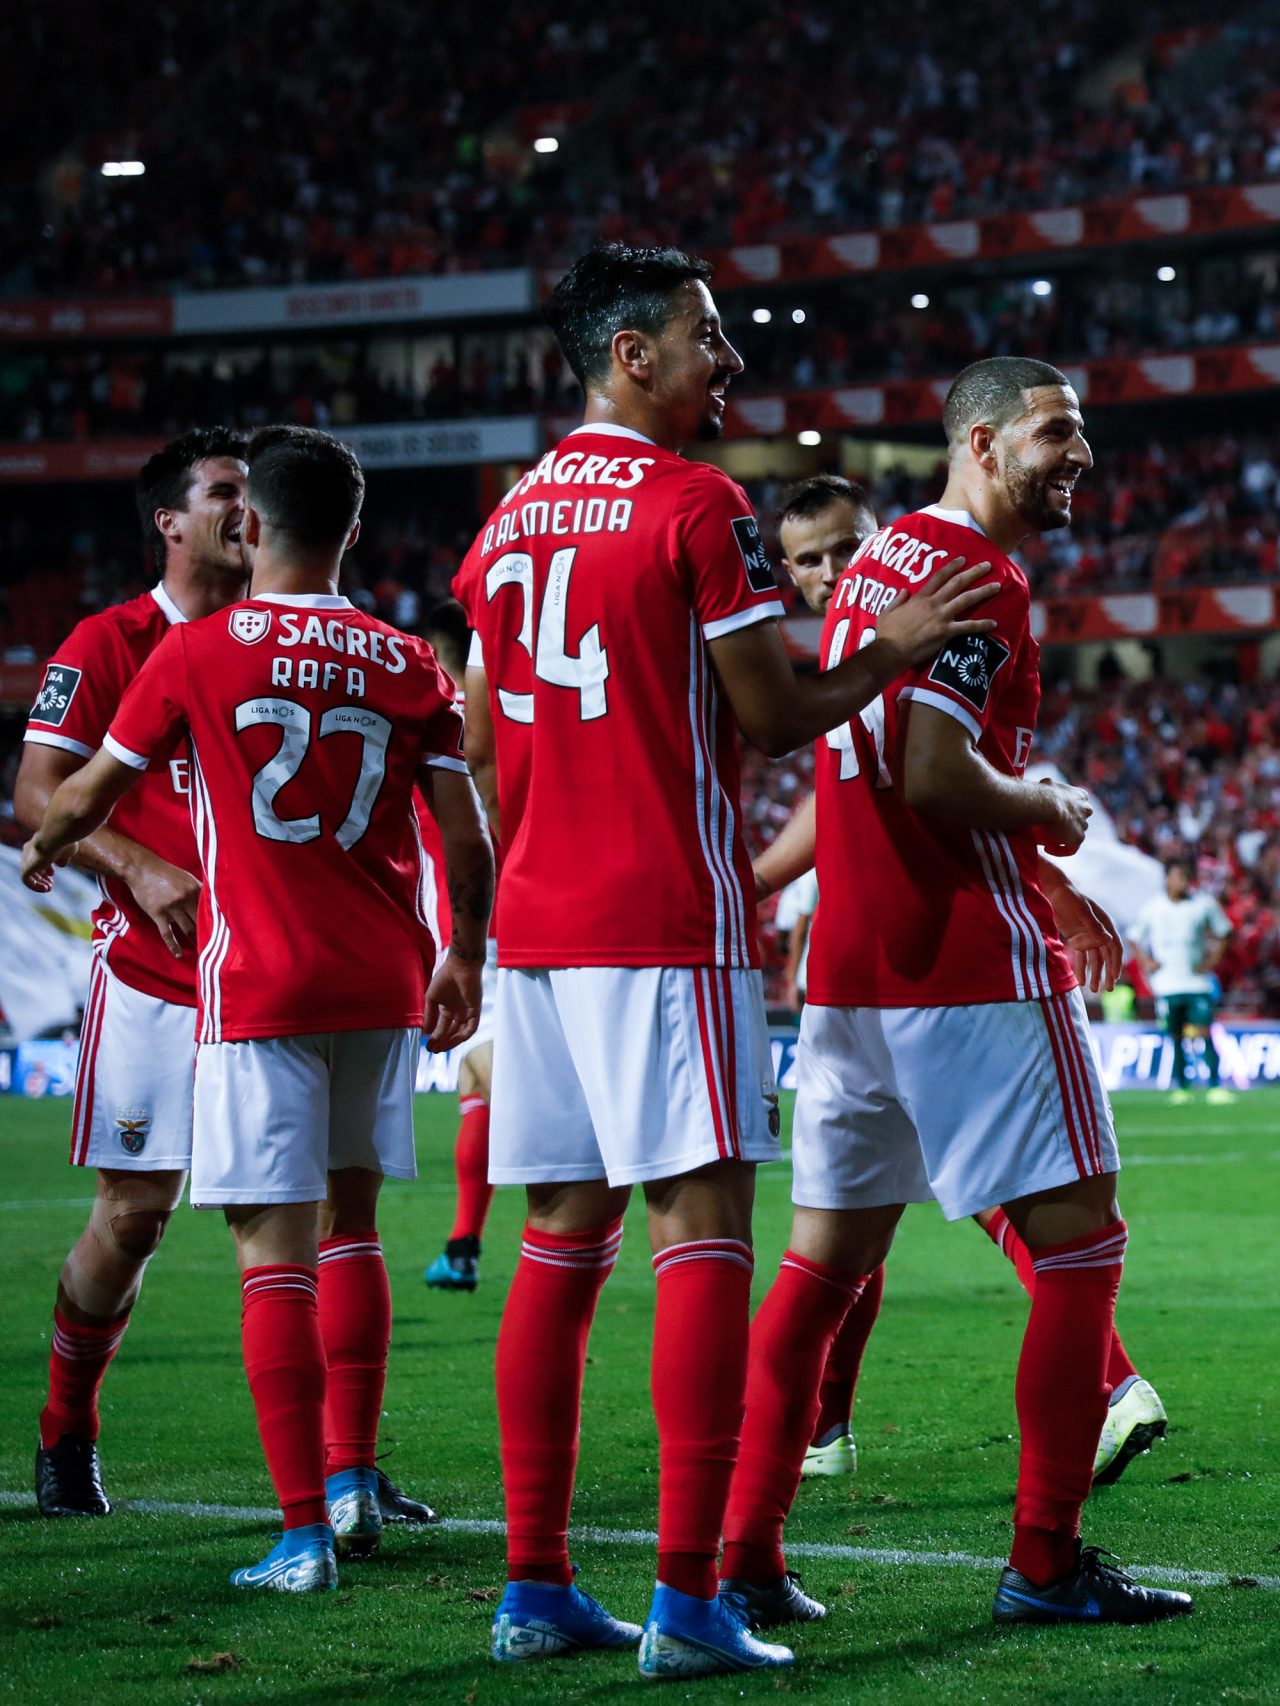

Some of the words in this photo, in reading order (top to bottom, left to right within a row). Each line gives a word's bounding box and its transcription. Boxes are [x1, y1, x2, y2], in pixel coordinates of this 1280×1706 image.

[277, 613, 408, 675] SAGRES
[486, 546, 611, 725] 34
[271, 656, 367, 698] RAFA
[251, 707, 270, 715] LIGA
[335, 714, 351, 723] LIGA
[233, 696, 393, 852] 27
